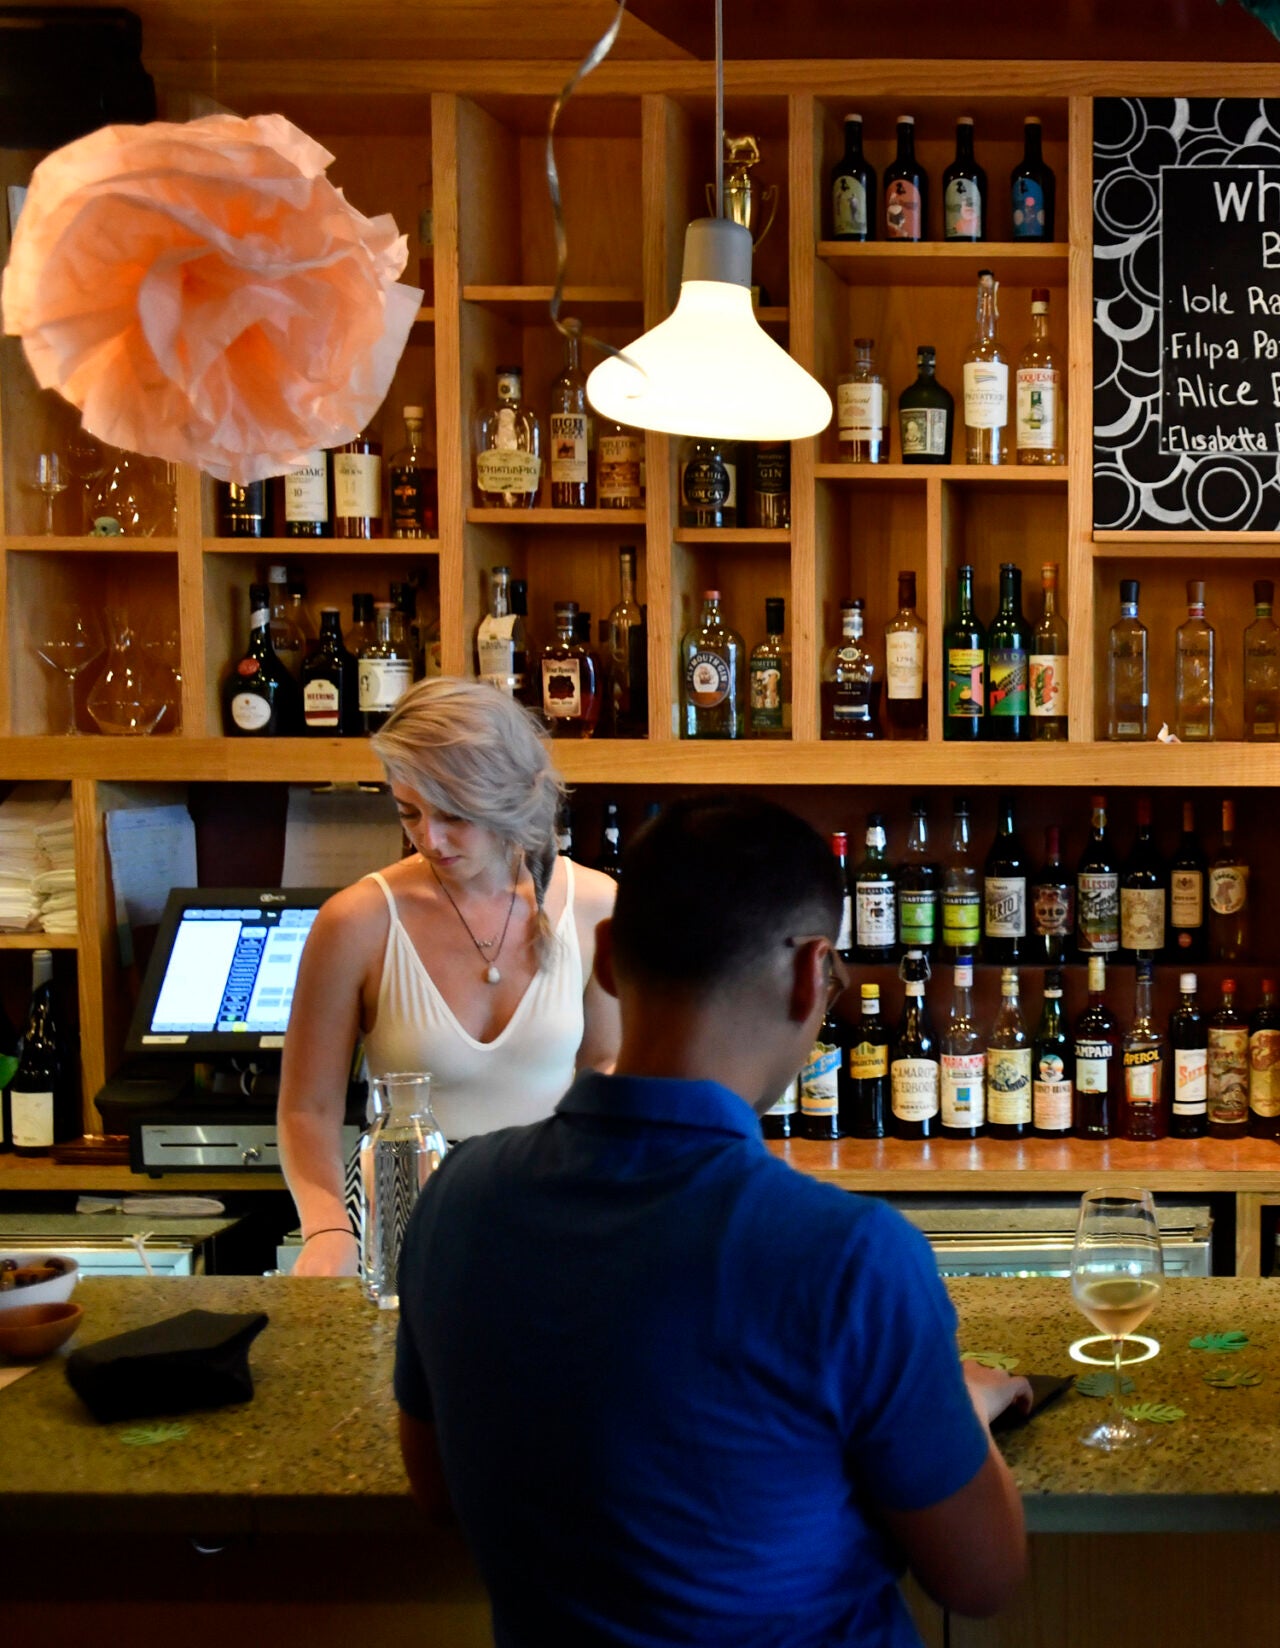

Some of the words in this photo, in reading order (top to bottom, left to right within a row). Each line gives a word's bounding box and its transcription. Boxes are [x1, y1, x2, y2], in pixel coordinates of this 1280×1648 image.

[1172, 331, 1240, 370] Filipa
[1177, 373, 1260, 408] Alice
[1168, 424, 1268, 451] Elisabetta
[1123, 1050, 1160, 1066] APEROL
